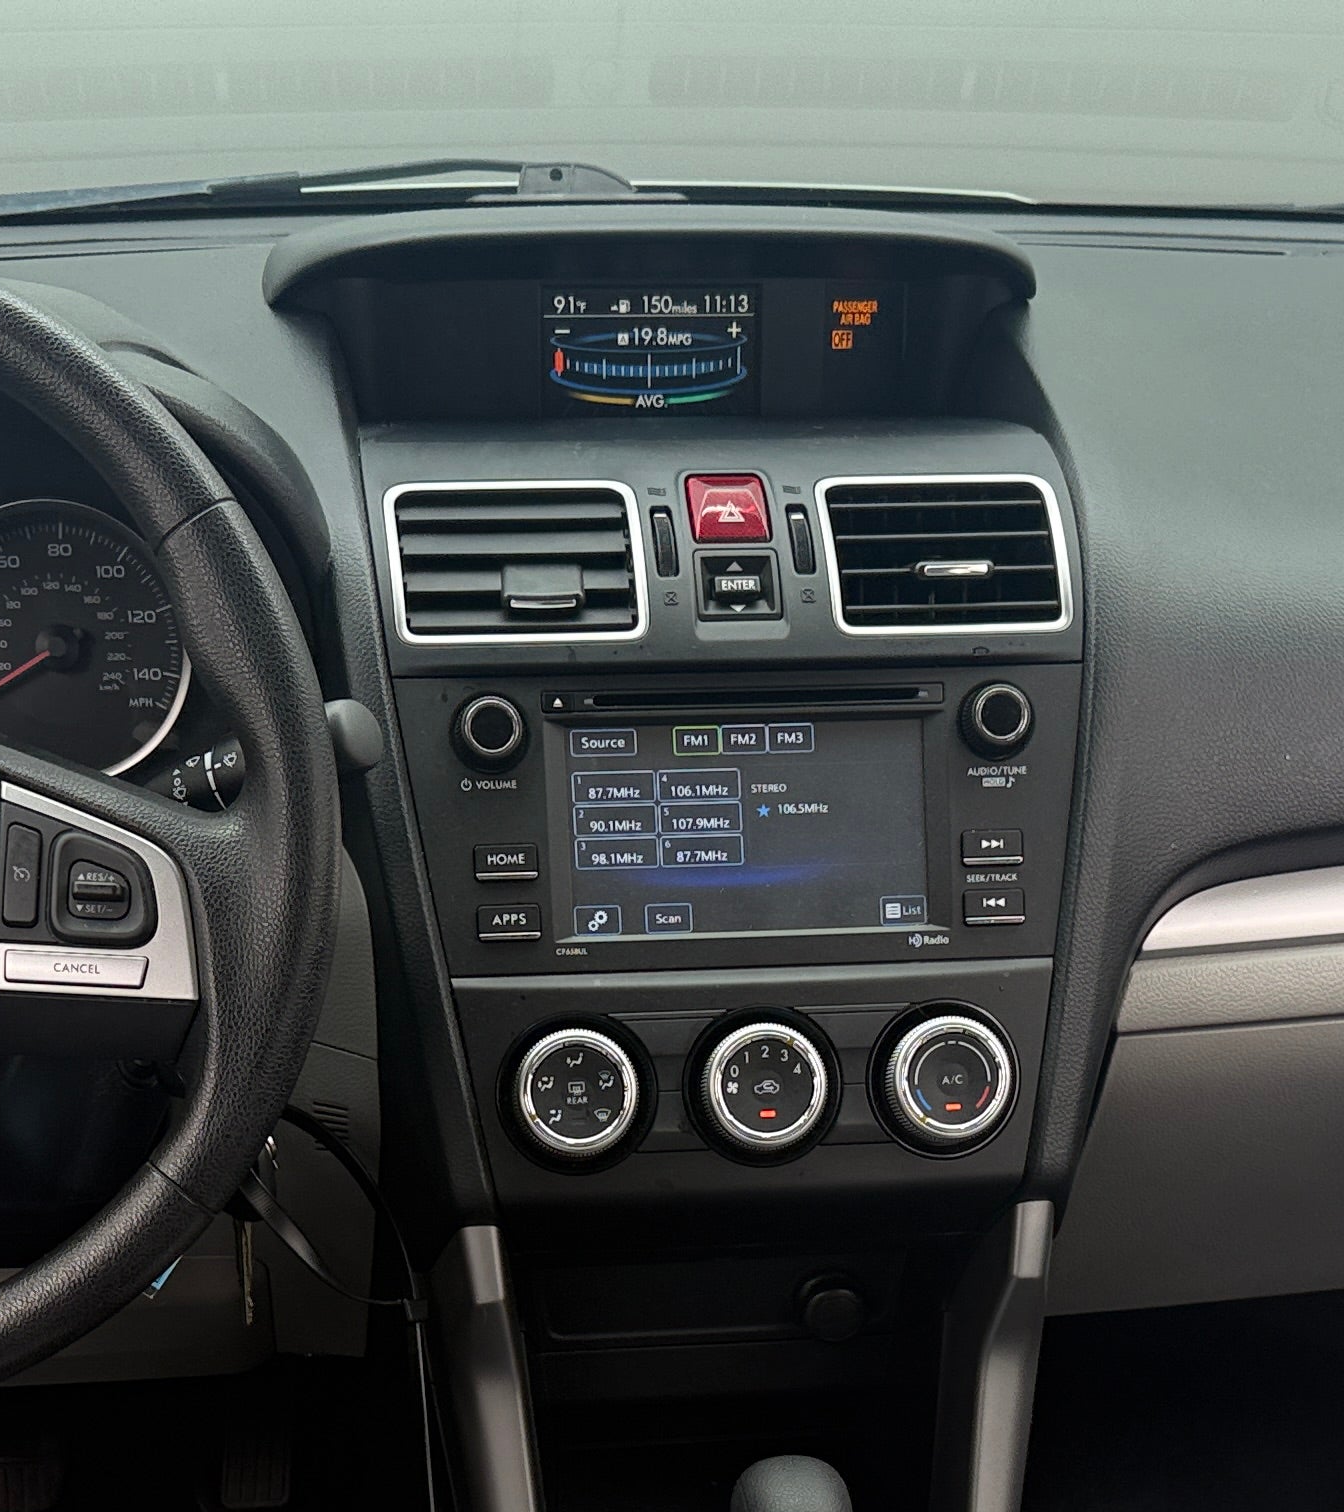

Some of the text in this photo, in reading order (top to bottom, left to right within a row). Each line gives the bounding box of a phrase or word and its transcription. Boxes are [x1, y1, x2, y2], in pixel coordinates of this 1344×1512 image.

[704, 294, 749, 313] 11:13
[832, 300, 878, 313] PASSENGER
[840, 313, 872, 326] AIR BAG
[833, 332, 852, 348] OFF
[635, 395, 668, 408] AVG.
[48, 544, 72, 556] 80
[96, 565, 125, 578] 100
[42, 581, 60, 590] 120
[721, 579, 756, 591] ENTER
[20, 587, 38, 596] 100
[128, 610, 156, 623] 120
[102, 672, 122, 681] 240
[133, 668, 162, 680] 140
[129, 698, 153, 708] MPH
[581, 736, 626, 750] Source
[683, 734, 708, 746] FM1
[730, 733, 756, 746] FM2
[777, 732, 804, 744] FM3
[967, 766, 1026, 776] AUDIO/TUNE
[662, 774, 668, 782] 4
[476, 780, 517, 790] VOLUME
[670, 785, 728, 797] 106.1MHz
[750, 784, 788, 794] STEREO
[588, 788, 640, 799] 87.7MHz
[578, 810, 584, 818] 2
[664, 808, 670, 816] 5
[778, 804, 828, 814] 106.5MHz
[590, 820, 642, 832] 90.1MHz
[672, 818, 730, 830] 107.9MHz
[580, 842, 586, 850] 3
[665, 840, 672, 848] 6
[487, 853, 526, 865] HOME
[592, 853, 644, 865] 98.1MHz
[676, 851, 728, 862] 87.7MHz
[966, 873, 1017, 882] SEEK/TRACK
[902, 905, 922, 916] List
[492, 913, 526, 926] APPS
[656, 914, 682, 924] Scan
[924, 935, 950, 944] Radio
[53, 962, 100, 975] CANCEL
[744, 1052, 750, 1064] 1
[761, 1046, 770, 1058] 2
[780, 1049, 788, 1062] 3
[730, 1065, 740, 1078] 0
[793, 1062, 802, 1074] 4
[942, 1074, 964, 1084] A/C
[566, 1096, 588, 1104] REAR
